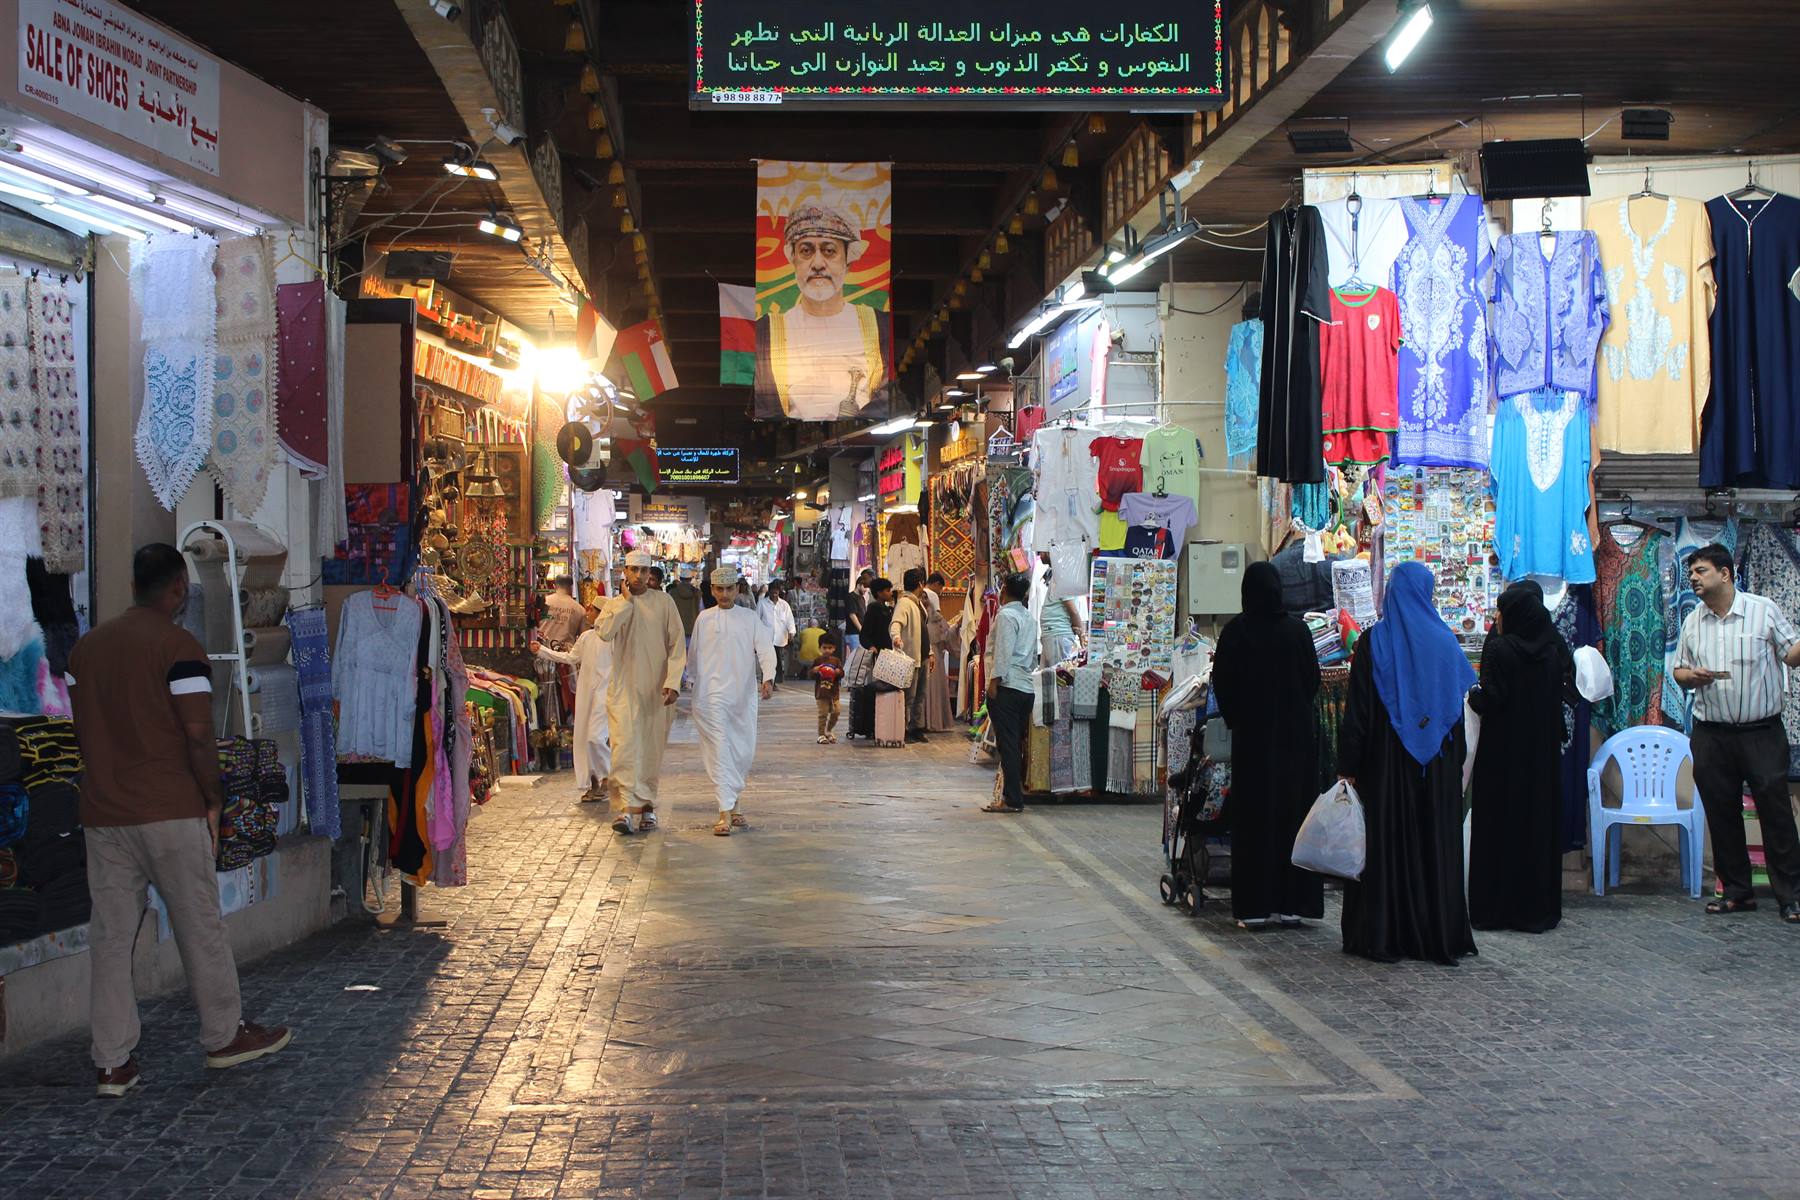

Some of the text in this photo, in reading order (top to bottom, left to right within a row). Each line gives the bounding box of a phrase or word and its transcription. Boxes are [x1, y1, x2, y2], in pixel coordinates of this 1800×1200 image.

[730, 22, 1179, 48] الكفارات هي ميزان العدالة الربانية التي تطهر
[53, 11, 198, 96] ABNA JOMAH IBRAHIM MORAD JOINT PARTNERSHIP
[728, 52, 1190, 78] النفوس و تكفر الذنوب و تعيد التوازن الى حياتنا
[26, 23, 128, 111] SALE OF SHOES
[138, 80, 187, 128] الأحذية
[723, 93, 779, 101] 98 98 88 77
[1132, 547, 1159, 556] QATAR
